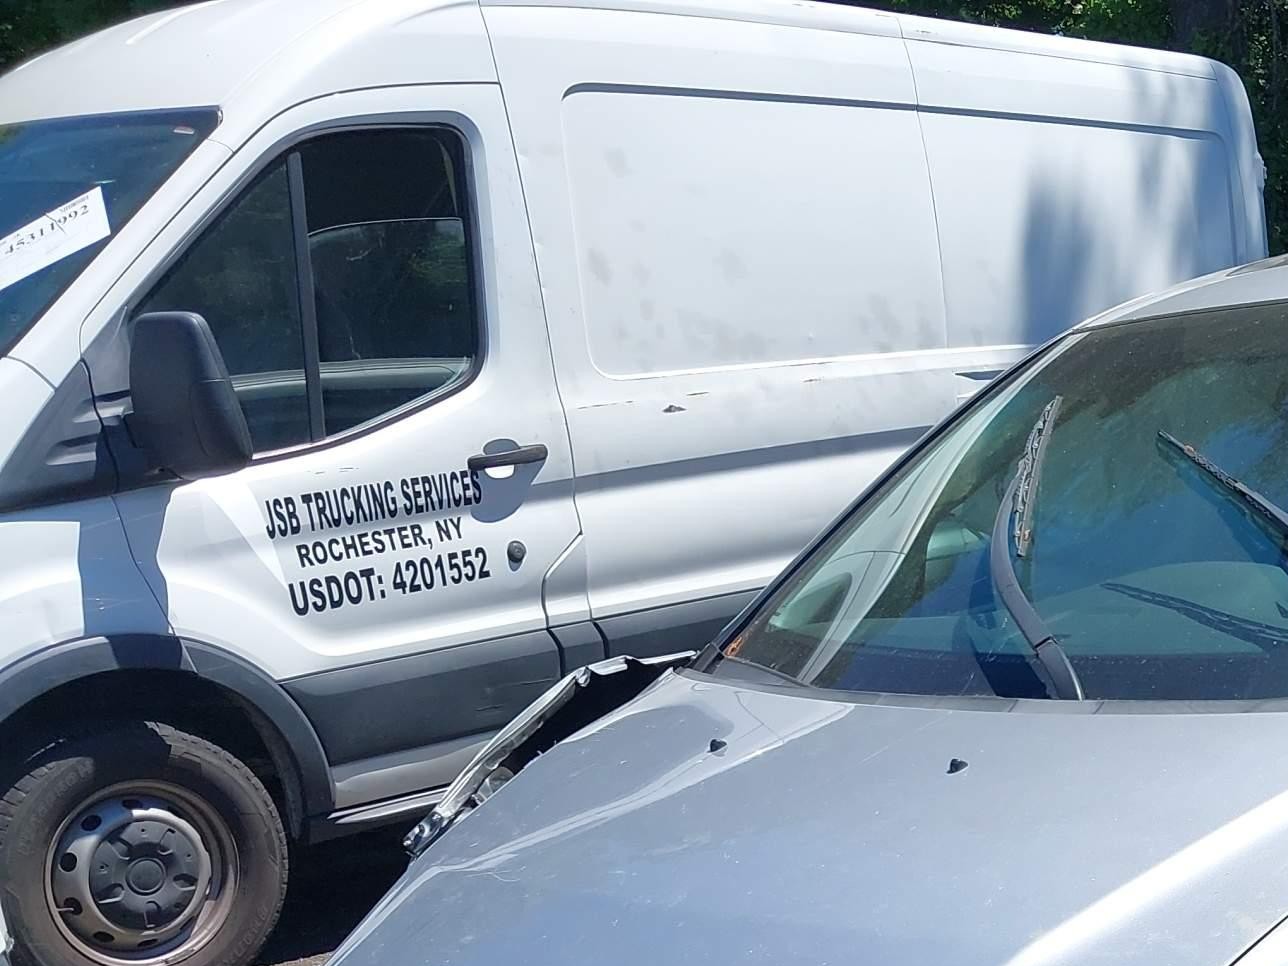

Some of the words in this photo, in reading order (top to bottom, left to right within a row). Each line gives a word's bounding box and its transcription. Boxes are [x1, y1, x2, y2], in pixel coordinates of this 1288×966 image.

[265, 497, 300, 540] JSB
[300, 481, 398, 532] TRUCKING
[400, 470, 482, 516] SERVICES
[296, 524, 433, 568] ROCHESTER,
[436, 517, 463, 543] NY
[288, 567, 386, 617] USDOT:
[392, 547, 491, 595] 4201552
